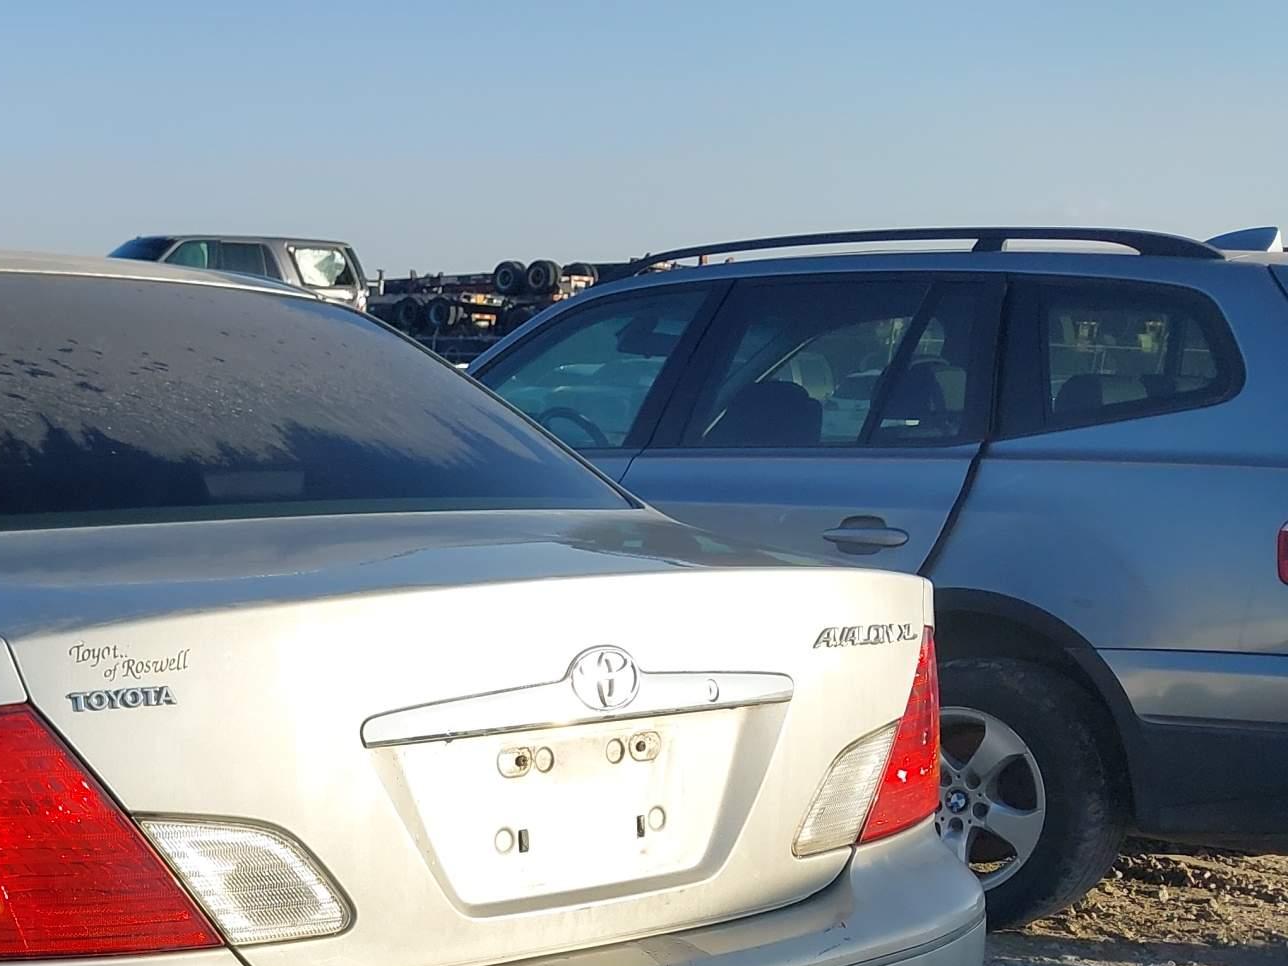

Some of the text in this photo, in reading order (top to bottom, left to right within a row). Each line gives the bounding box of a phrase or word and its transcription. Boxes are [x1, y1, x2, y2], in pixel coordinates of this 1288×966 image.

[103, 649, 190, 682] of Roswell
[66, 686, 178, 712] TOYOTA
